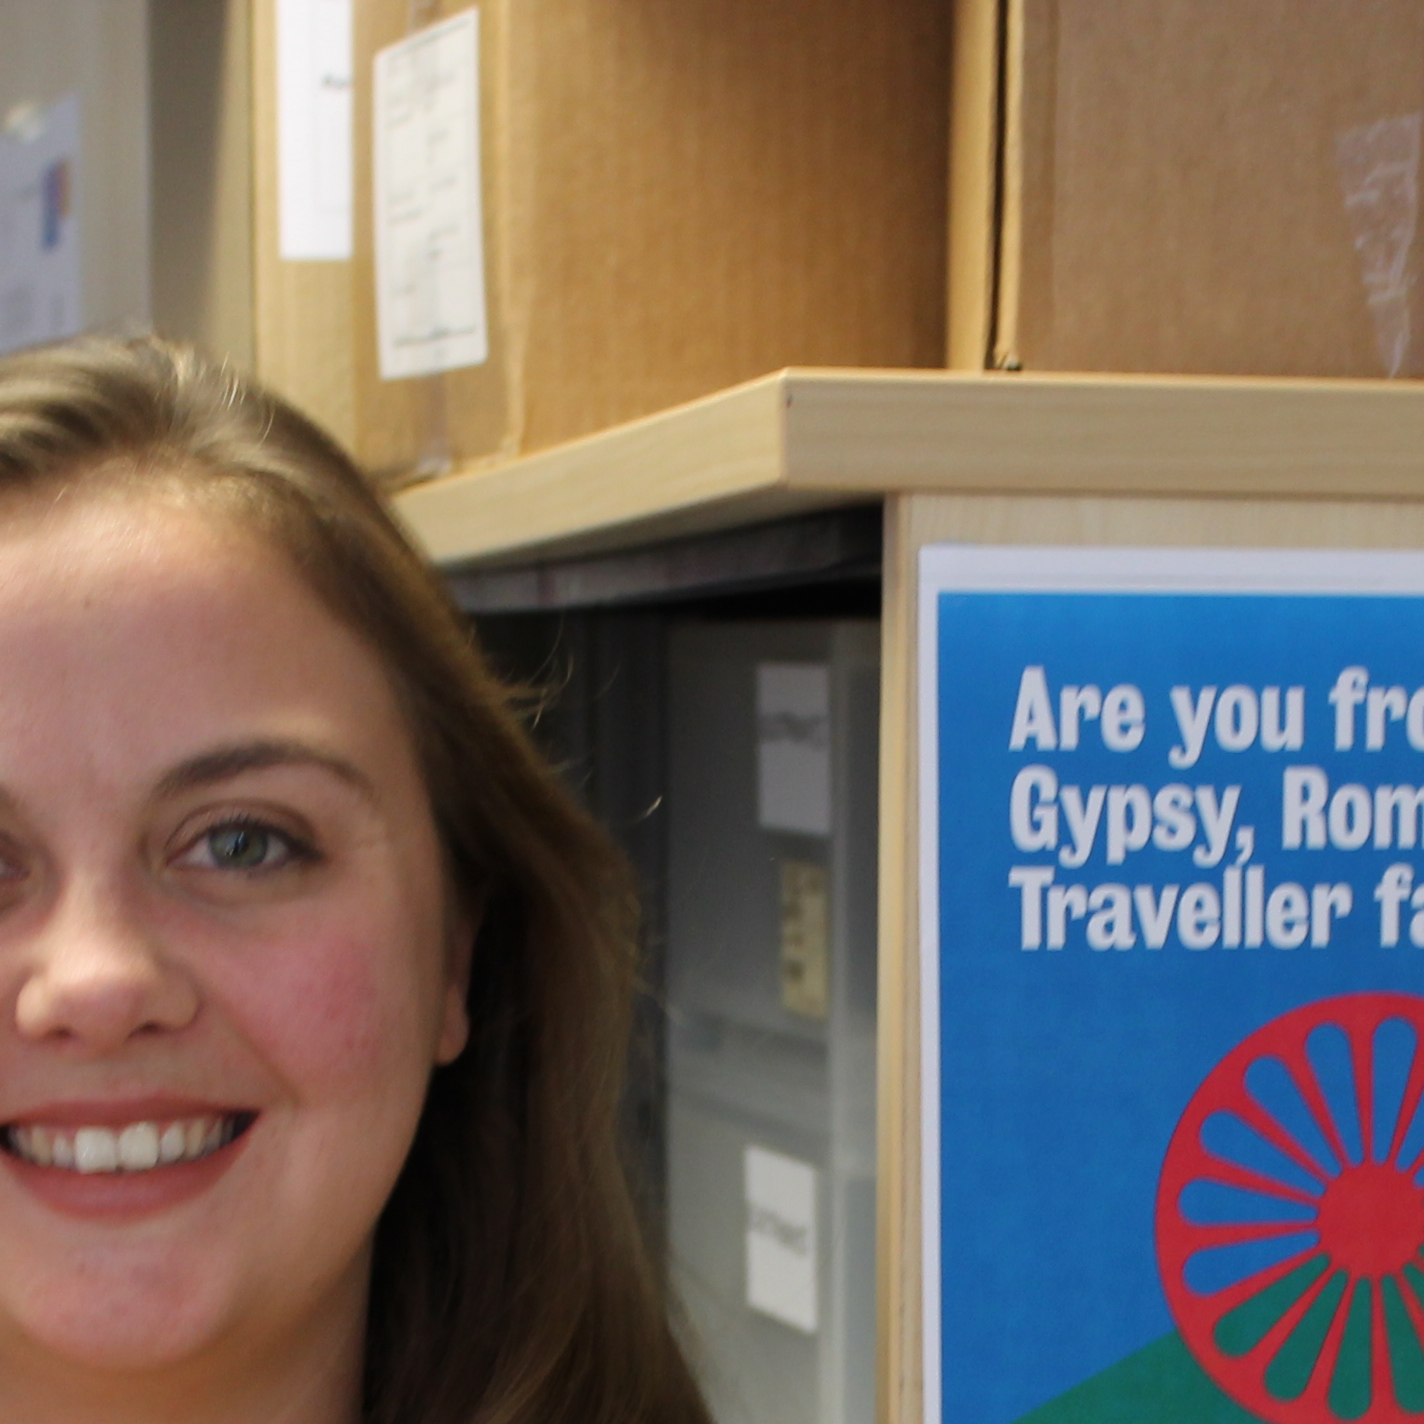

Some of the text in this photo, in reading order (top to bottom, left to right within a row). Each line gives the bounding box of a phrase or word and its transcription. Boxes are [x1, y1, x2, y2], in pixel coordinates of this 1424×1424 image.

[1008, 664, 1145, 752] Are
[1169, 684, 1305, 770] you
[1008, 764, 1255, 868] Gypsy,
[1007, 863, 1352, 951] Traveller
